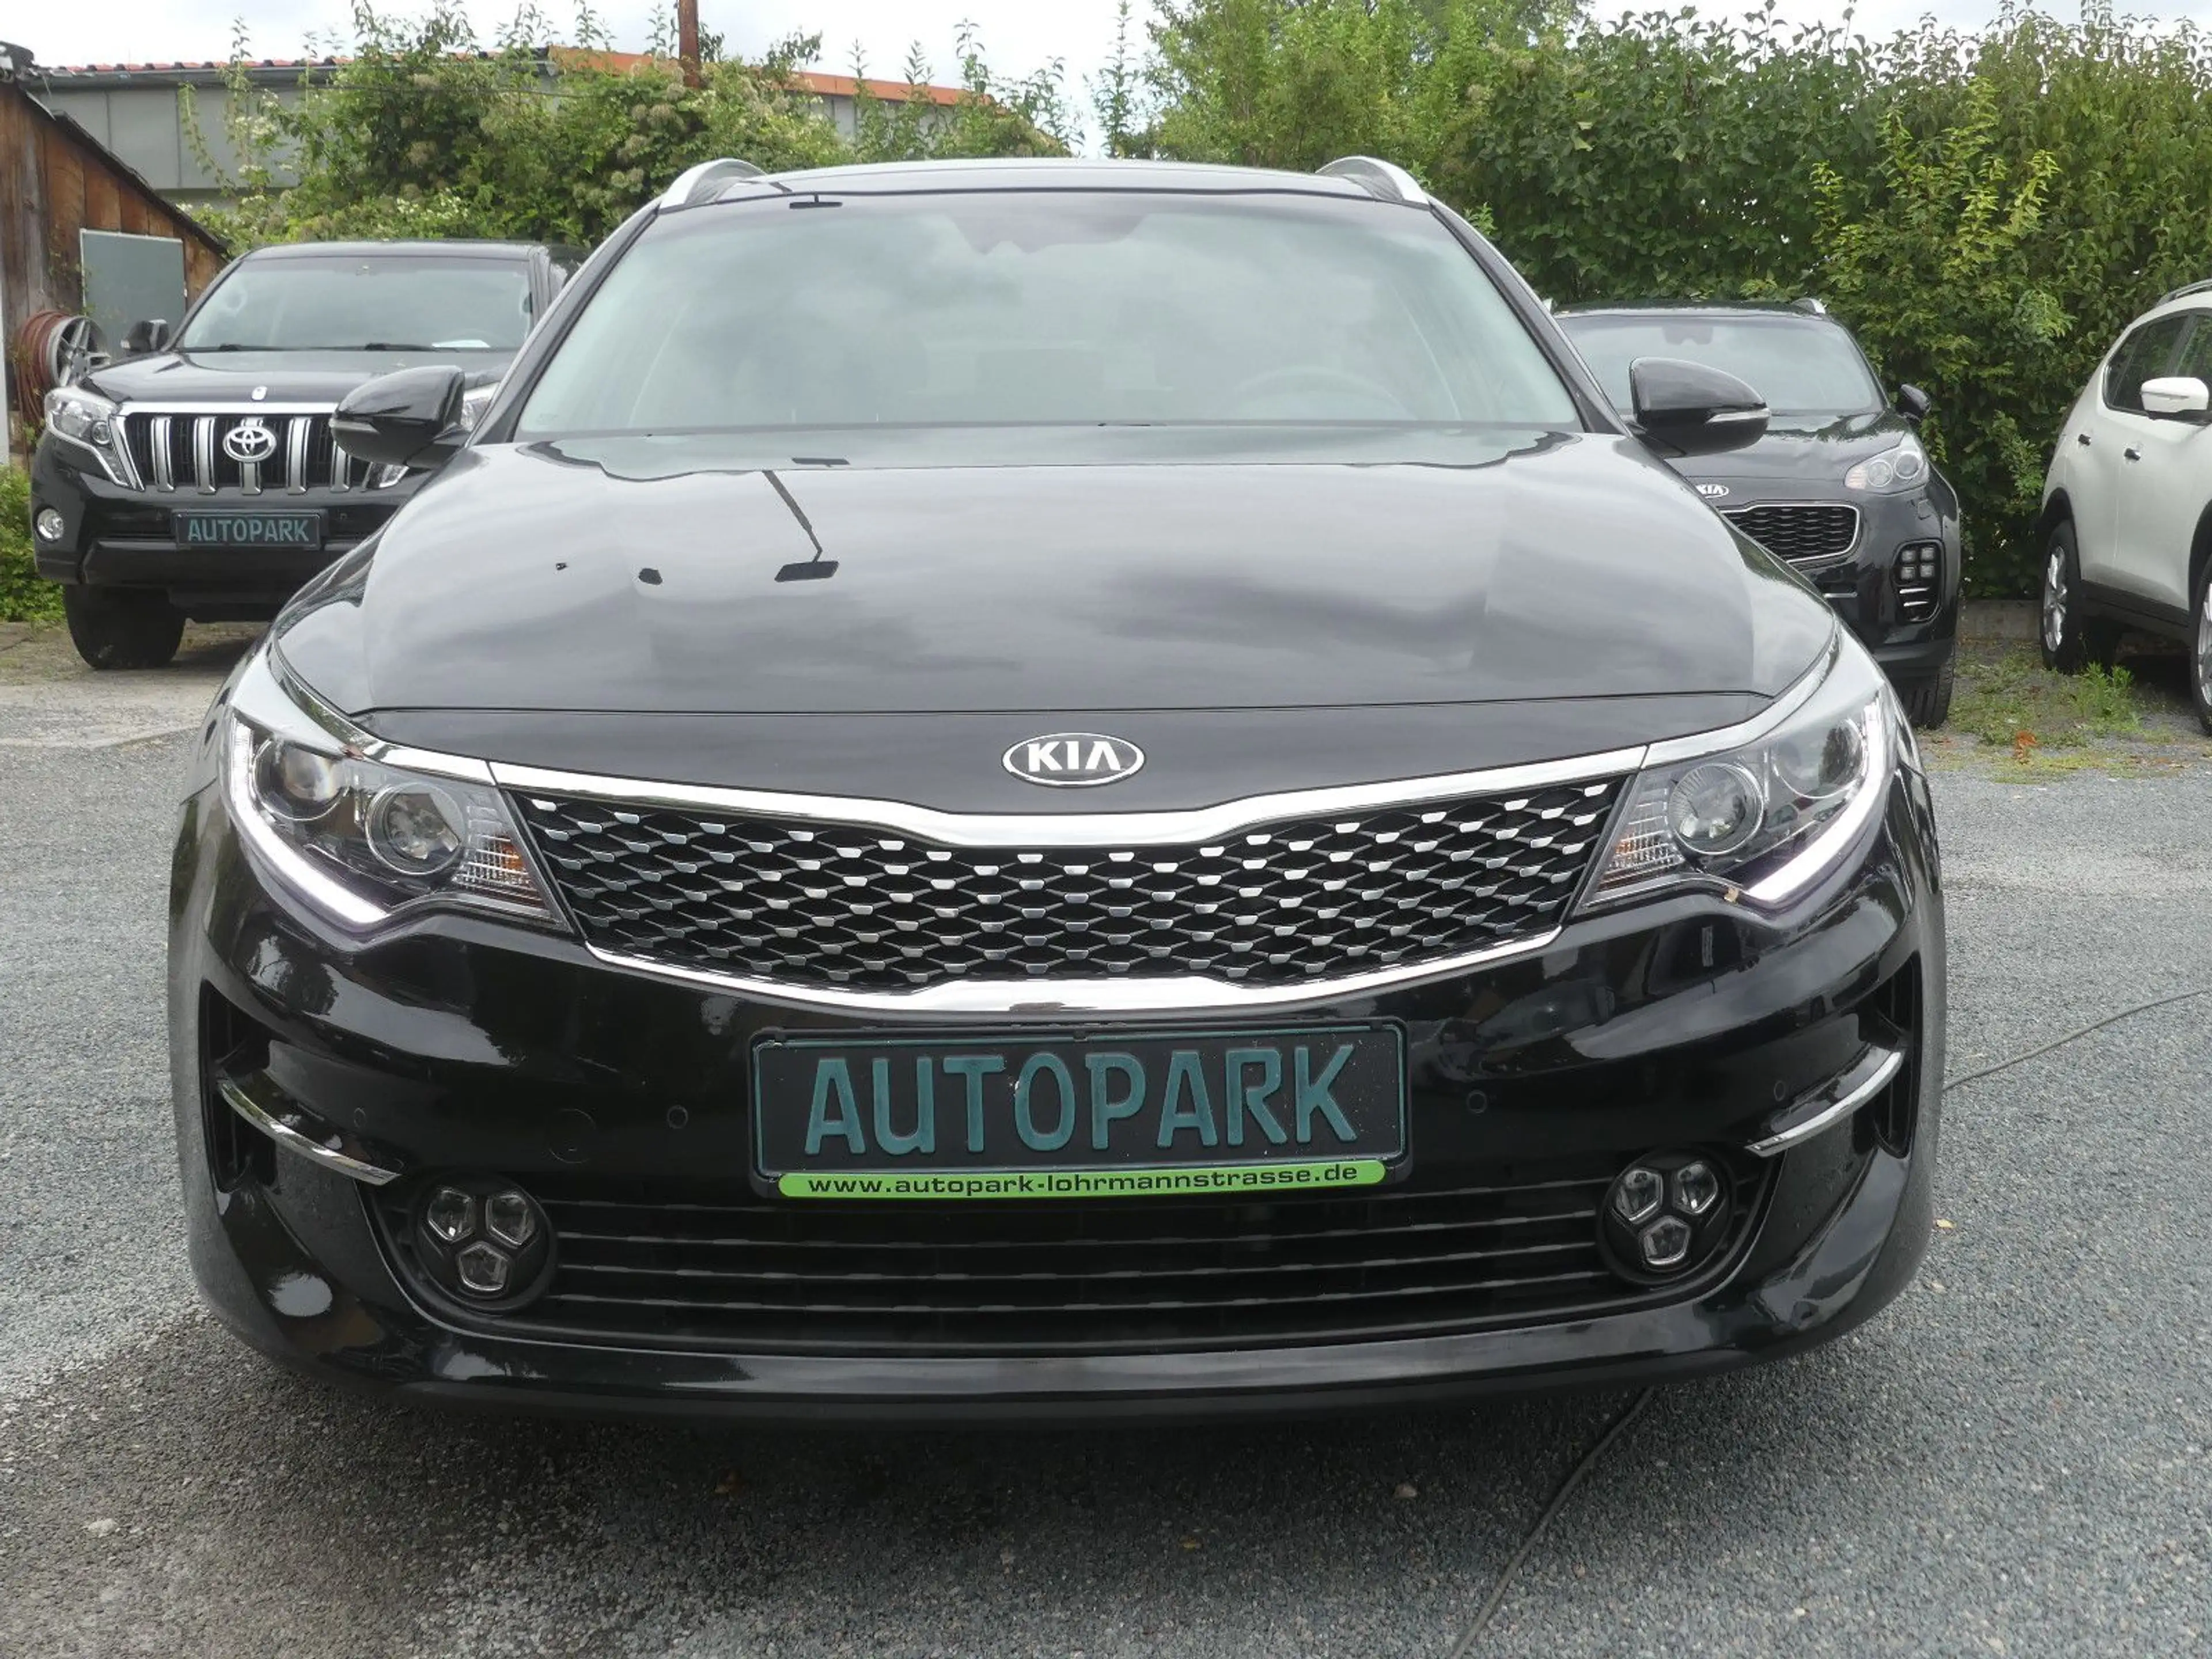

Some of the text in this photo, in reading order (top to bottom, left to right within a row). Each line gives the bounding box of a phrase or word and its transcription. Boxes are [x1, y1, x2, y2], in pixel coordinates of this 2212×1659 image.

[188, 519, 309, 542] AUTOPARK
[1027, 741, 1121, 772] KIA
[805, 1045, 1358, 1155] AUTOPARK
[808, 1164, 1358, 1196] www.autopark-lohrmannstrasse.de
